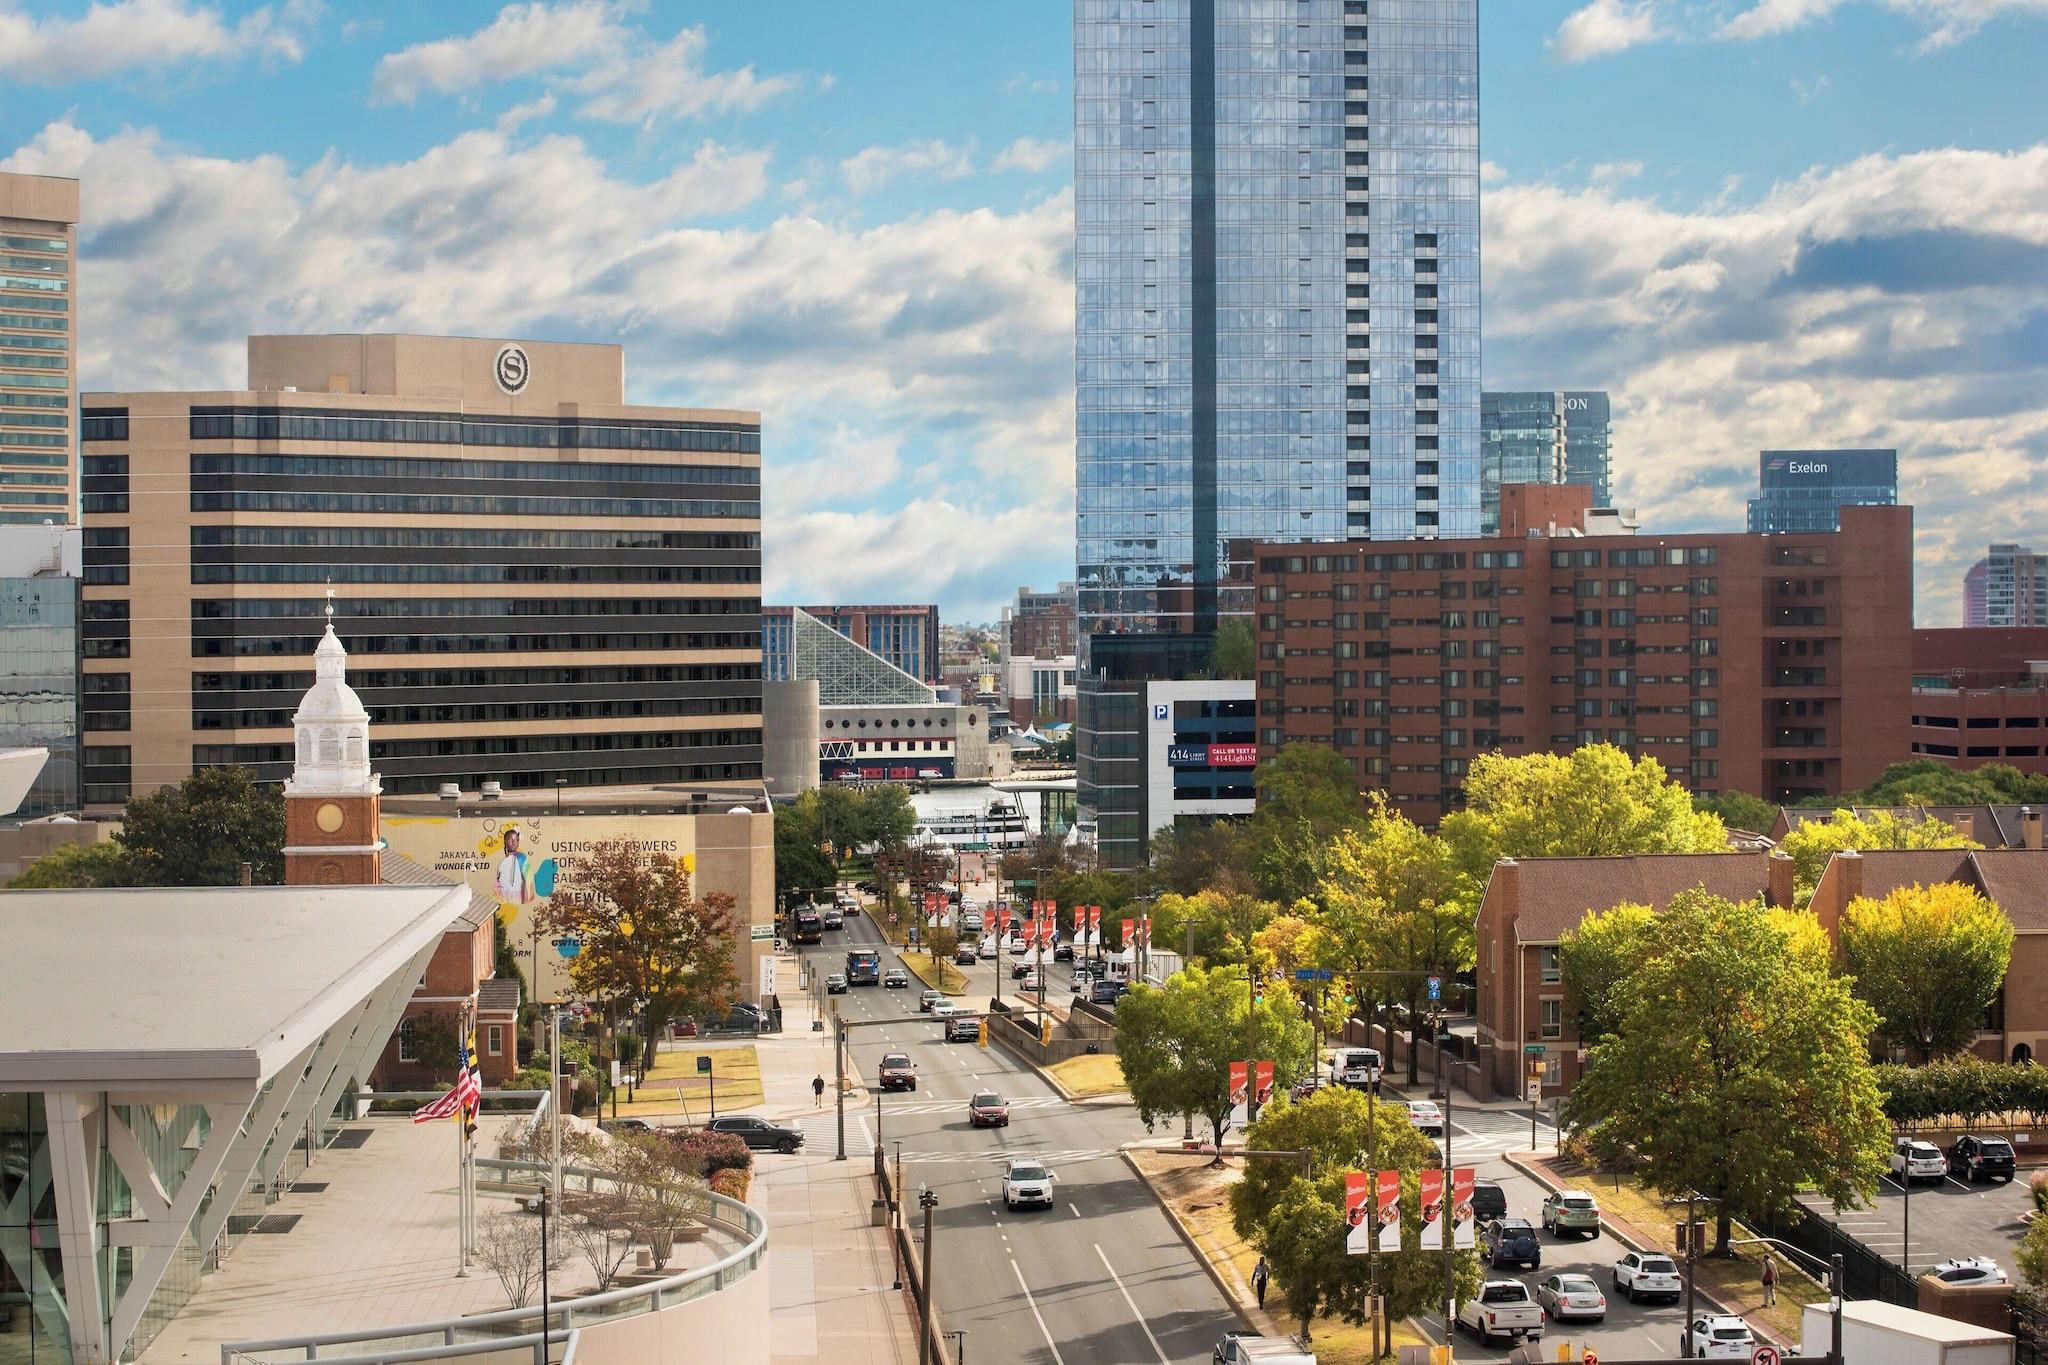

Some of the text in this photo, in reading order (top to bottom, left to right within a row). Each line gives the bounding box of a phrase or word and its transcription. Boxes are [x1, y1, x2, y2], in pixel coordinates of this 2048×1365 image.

[1789, 461, 1828, 473] Exelon
[1156, 705, 1167, 719] P
[1170, 749, 1189, 760] 414
[551, 840, 677, 852] USING OUR POWERS
[439, 851, 486, 860] JAKAYLA, 9
[434, 862, 490, 871] WONDER KID
[552, 857, 576, 868] FOR
[512, 949, 532, 957] ORM
[1429, 980, 1439, 990] 95
